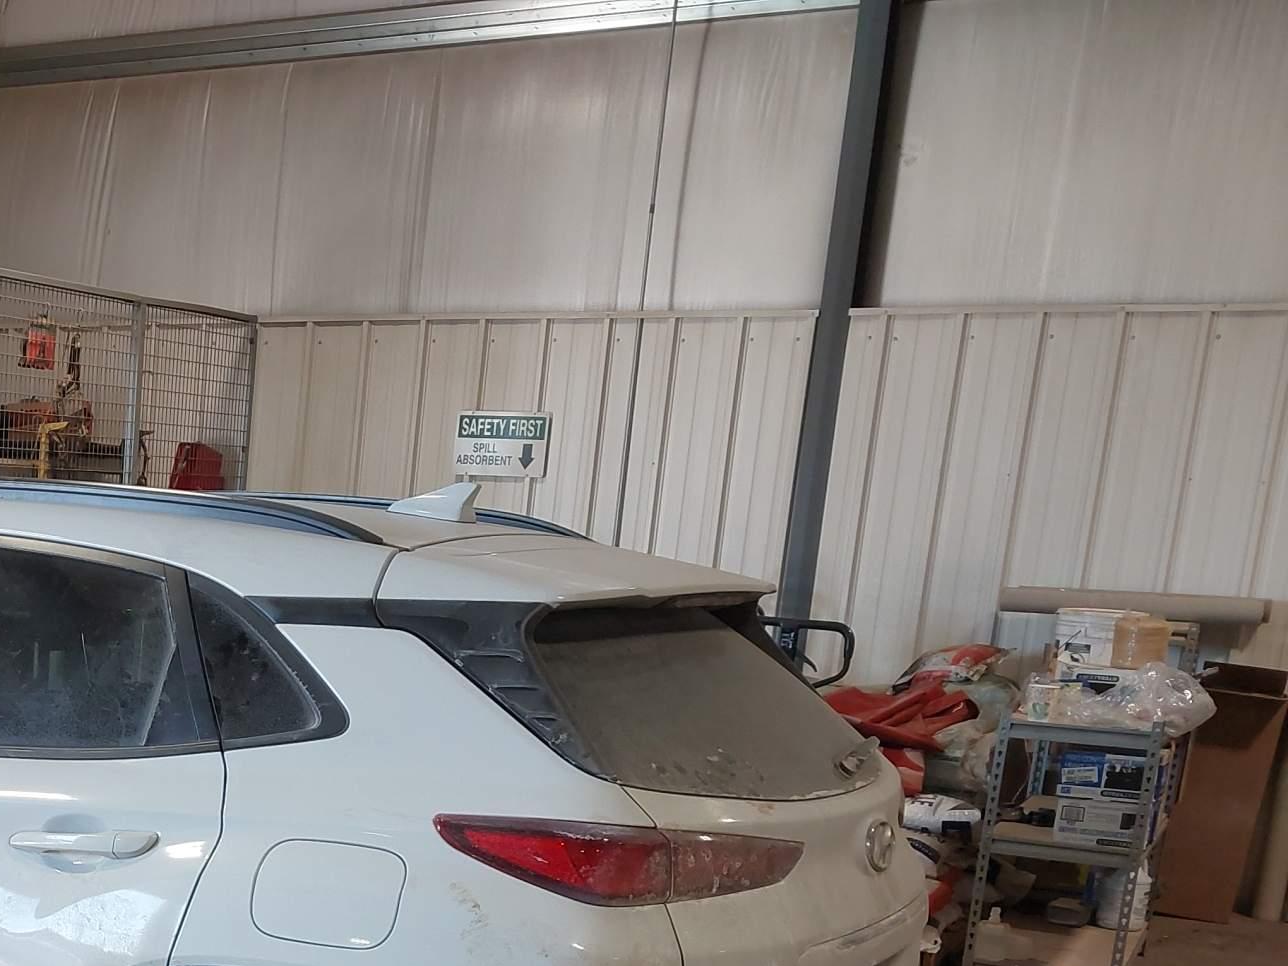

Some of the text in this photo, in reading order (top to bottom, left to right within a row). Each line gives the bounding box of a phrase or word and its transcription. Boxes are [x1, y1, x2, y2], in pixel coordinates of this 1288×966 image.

[462, 418, 543, 437] SAFETY FIRST
[472, 442, 498, 453] SPILL
[456, 454, 512, 466] ABSORBENT
